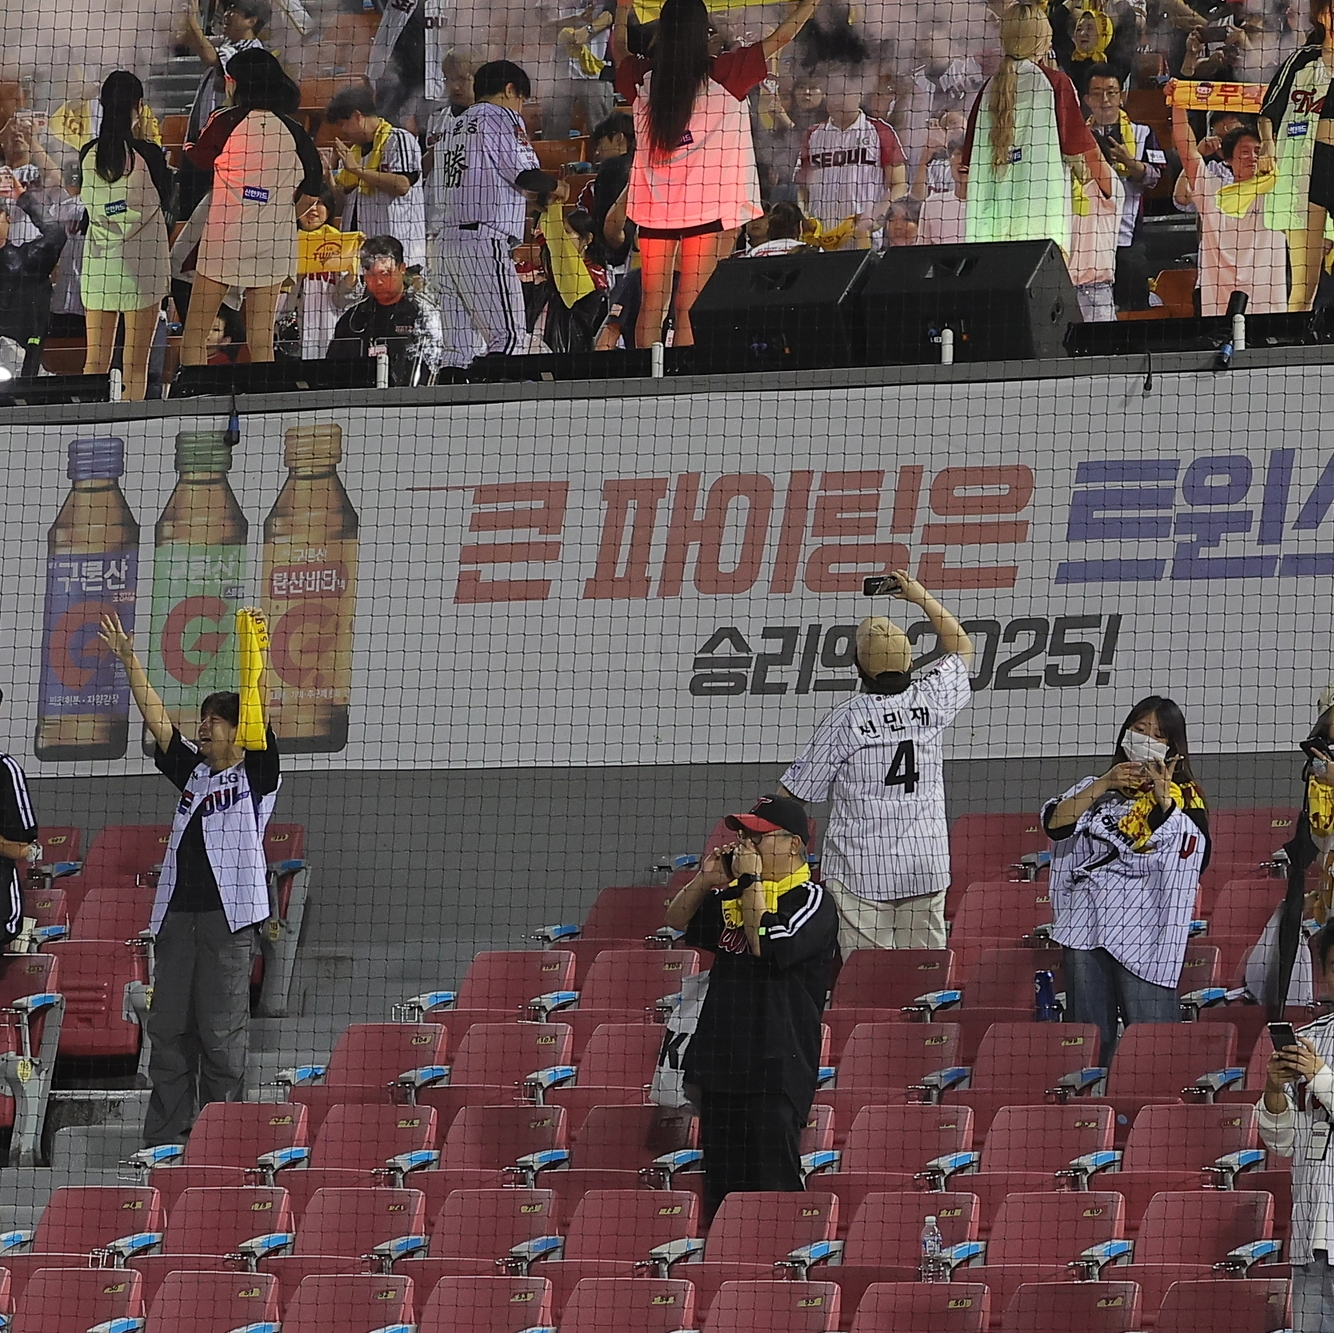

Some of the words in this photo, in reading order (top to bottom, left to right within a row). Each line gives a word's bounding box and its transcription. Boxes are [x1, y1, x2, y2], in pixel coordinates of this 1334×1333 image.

[443, 143, 467, 190] 勝
[809, 148, 876, 168] SEOUL
[432, 479, 569, 606] 큰
[582, 463, 1034, 601] 파이팅은
[56, 558, 130, 594] 구론산
[857, 707, 930, 740] 신민재
[218, 771, 240, 786] LG
[884, 739, 920, 794] 4
